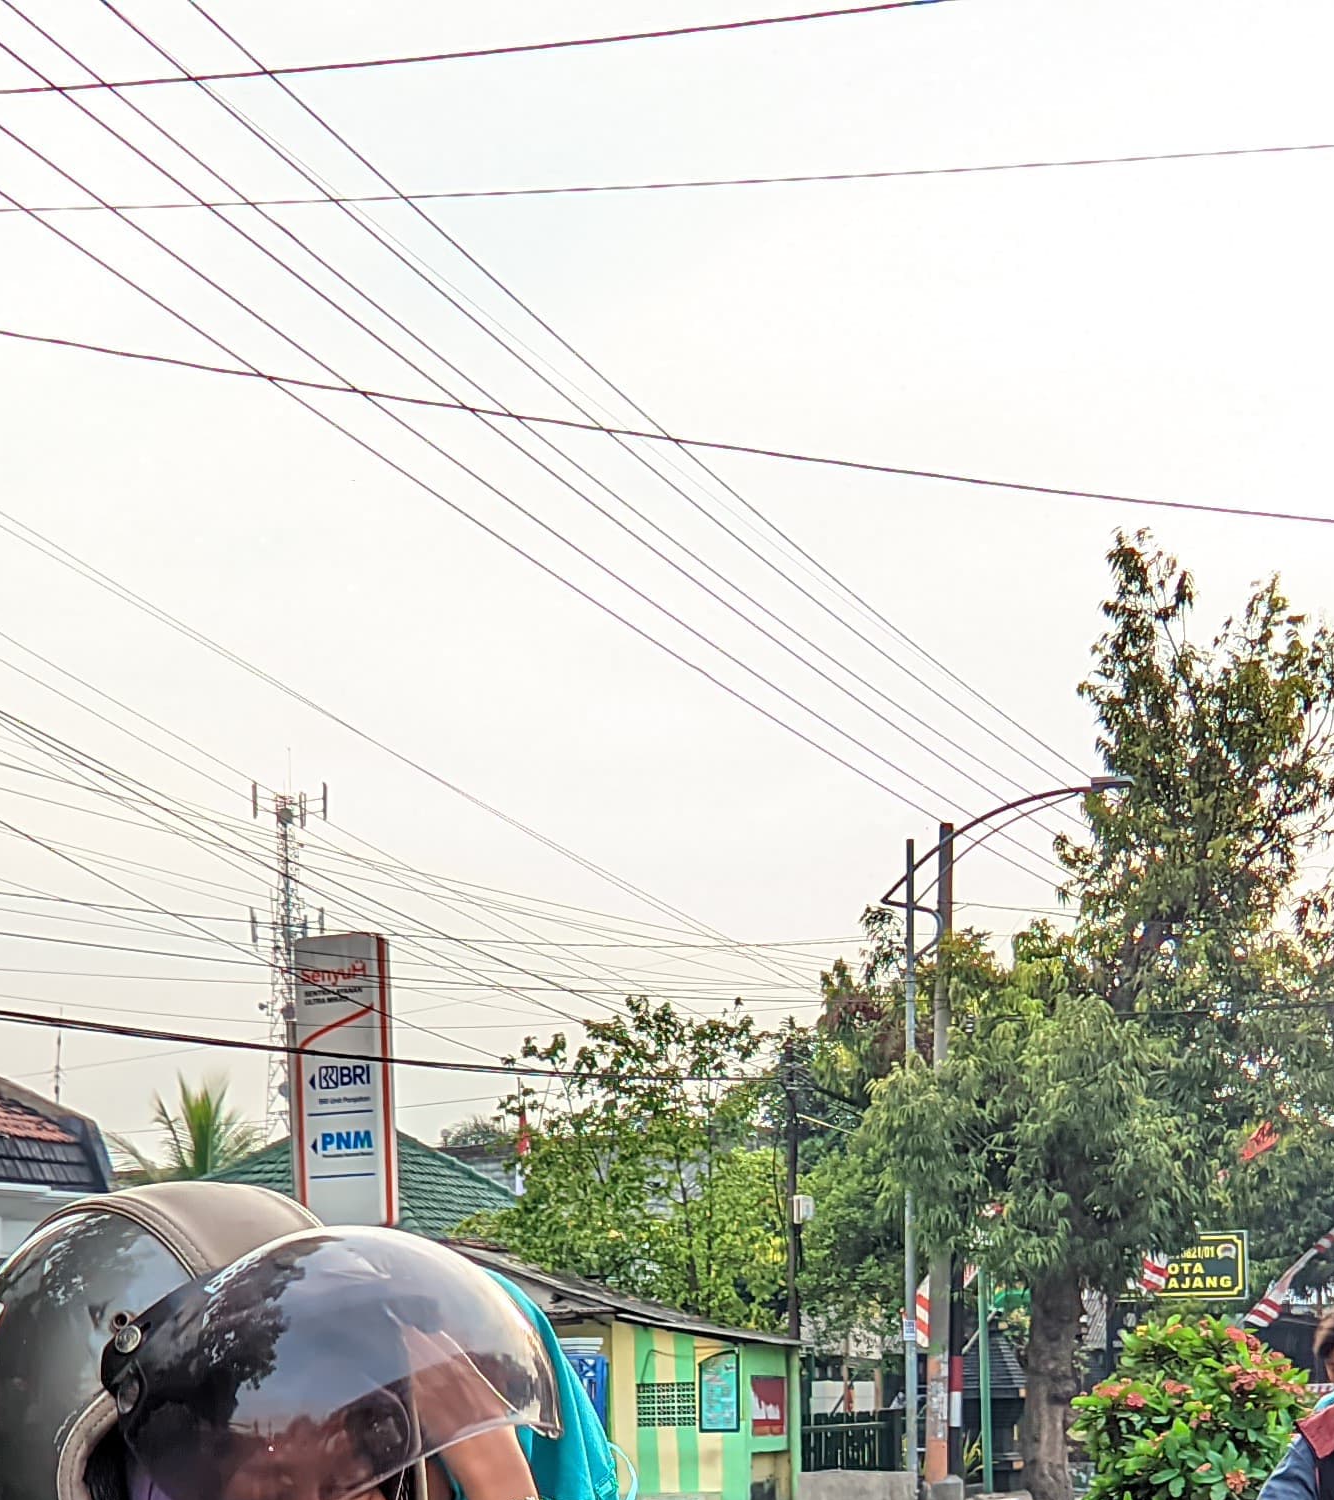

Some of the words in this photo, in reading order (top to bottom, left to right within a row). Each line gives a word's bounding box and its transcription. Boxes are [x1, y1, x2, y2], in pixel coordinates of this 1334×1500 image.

[339, 1064, 371, 1087] BRI
[321, 1130, 373, 1151] PNM
[1167, 1263, 1205, 1275] OTA
